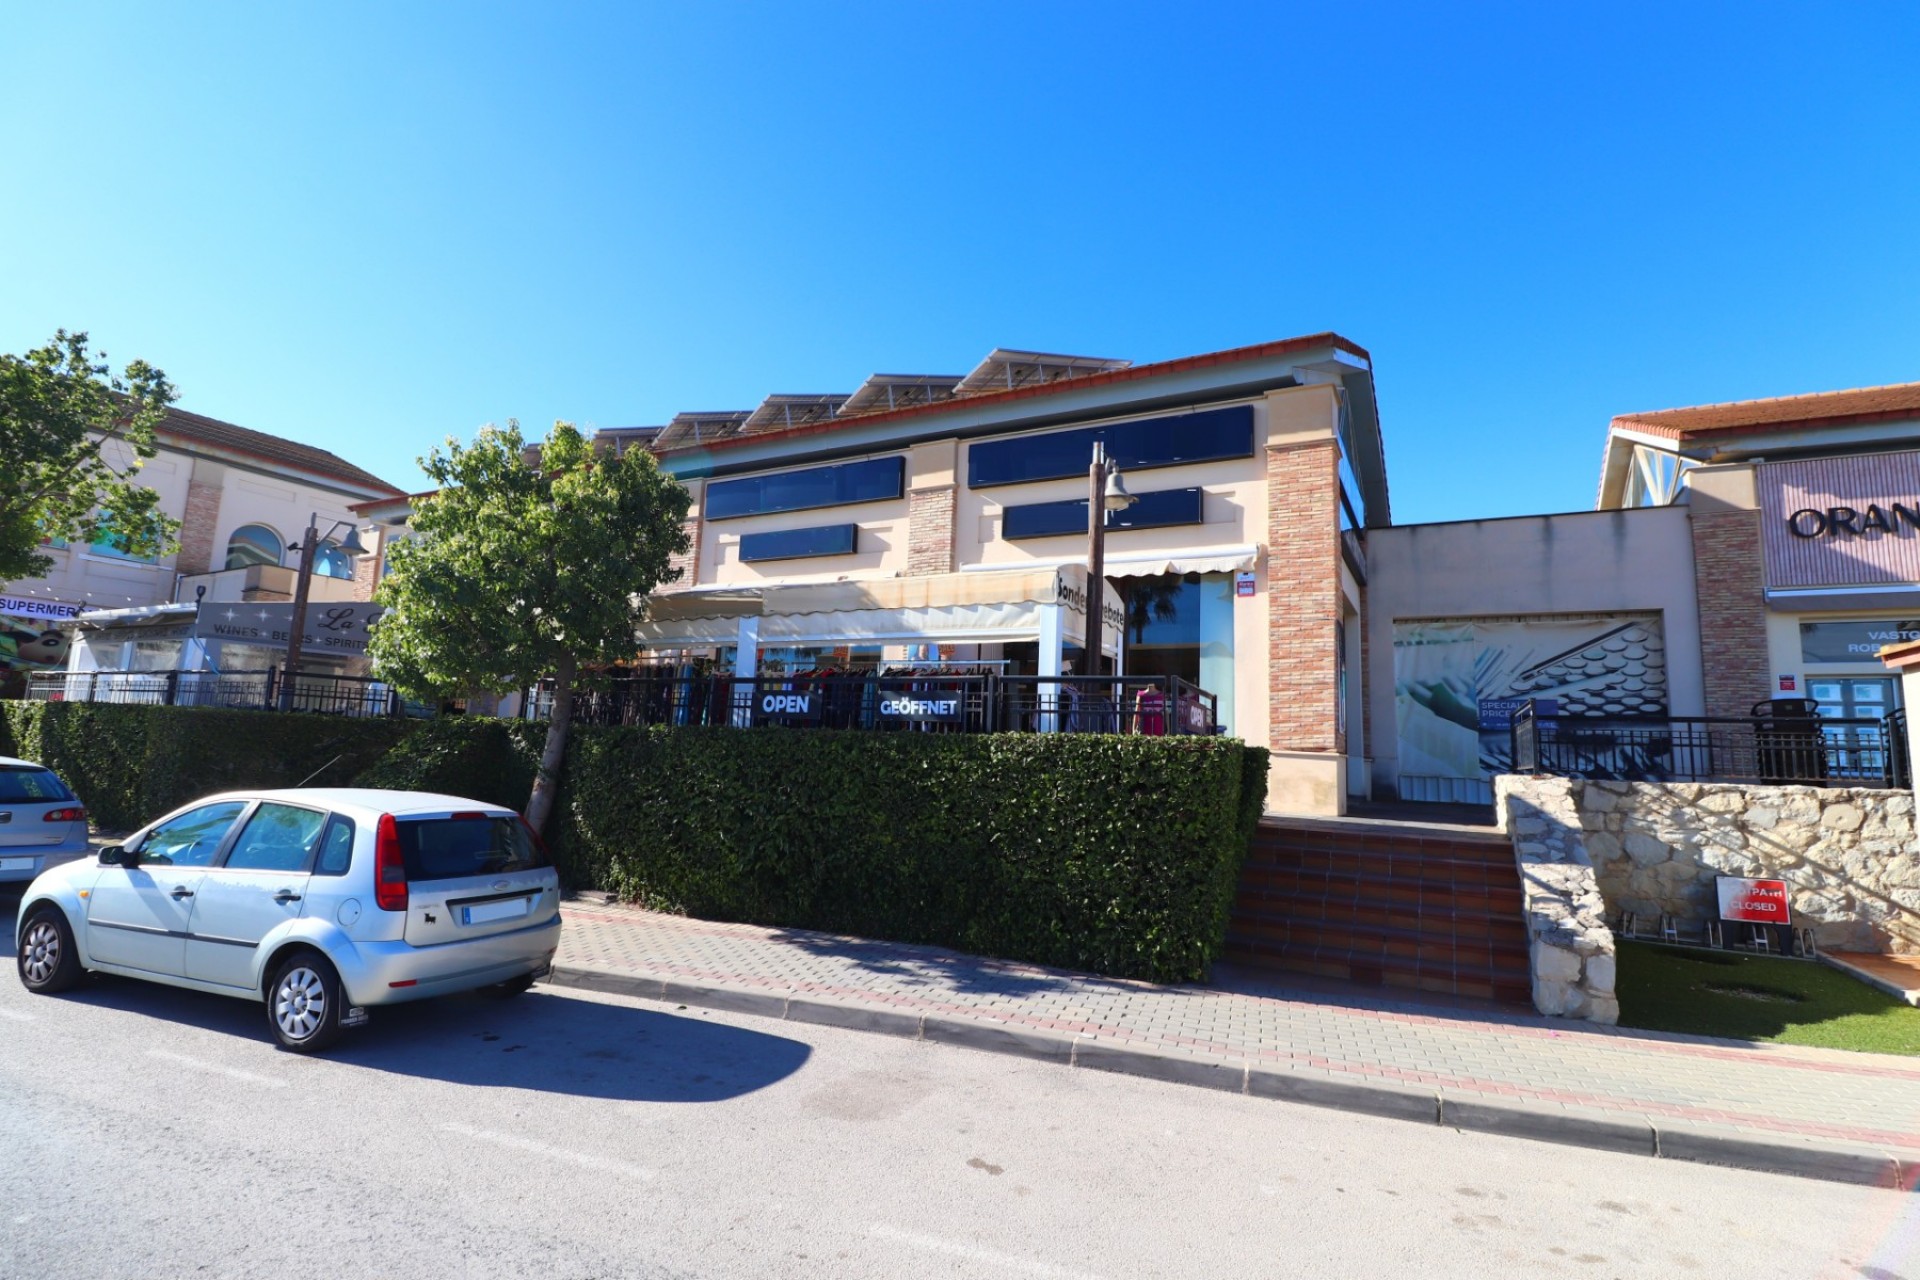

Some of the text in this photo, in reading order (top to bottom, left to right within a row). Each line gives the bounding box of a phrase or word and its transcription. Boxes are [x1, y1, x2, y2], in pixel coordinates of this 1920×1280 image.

[1789, 502, 1920, 538] ORAN
[318, 608, 354, 631] La
[214, 623, 259, 637] WINES
[325, 637, 369, 649] SPIRITS
[763, 695, 957, 715] OPEN GEÖFFNET
[1731, 901, 1777, 912] CLOSED
